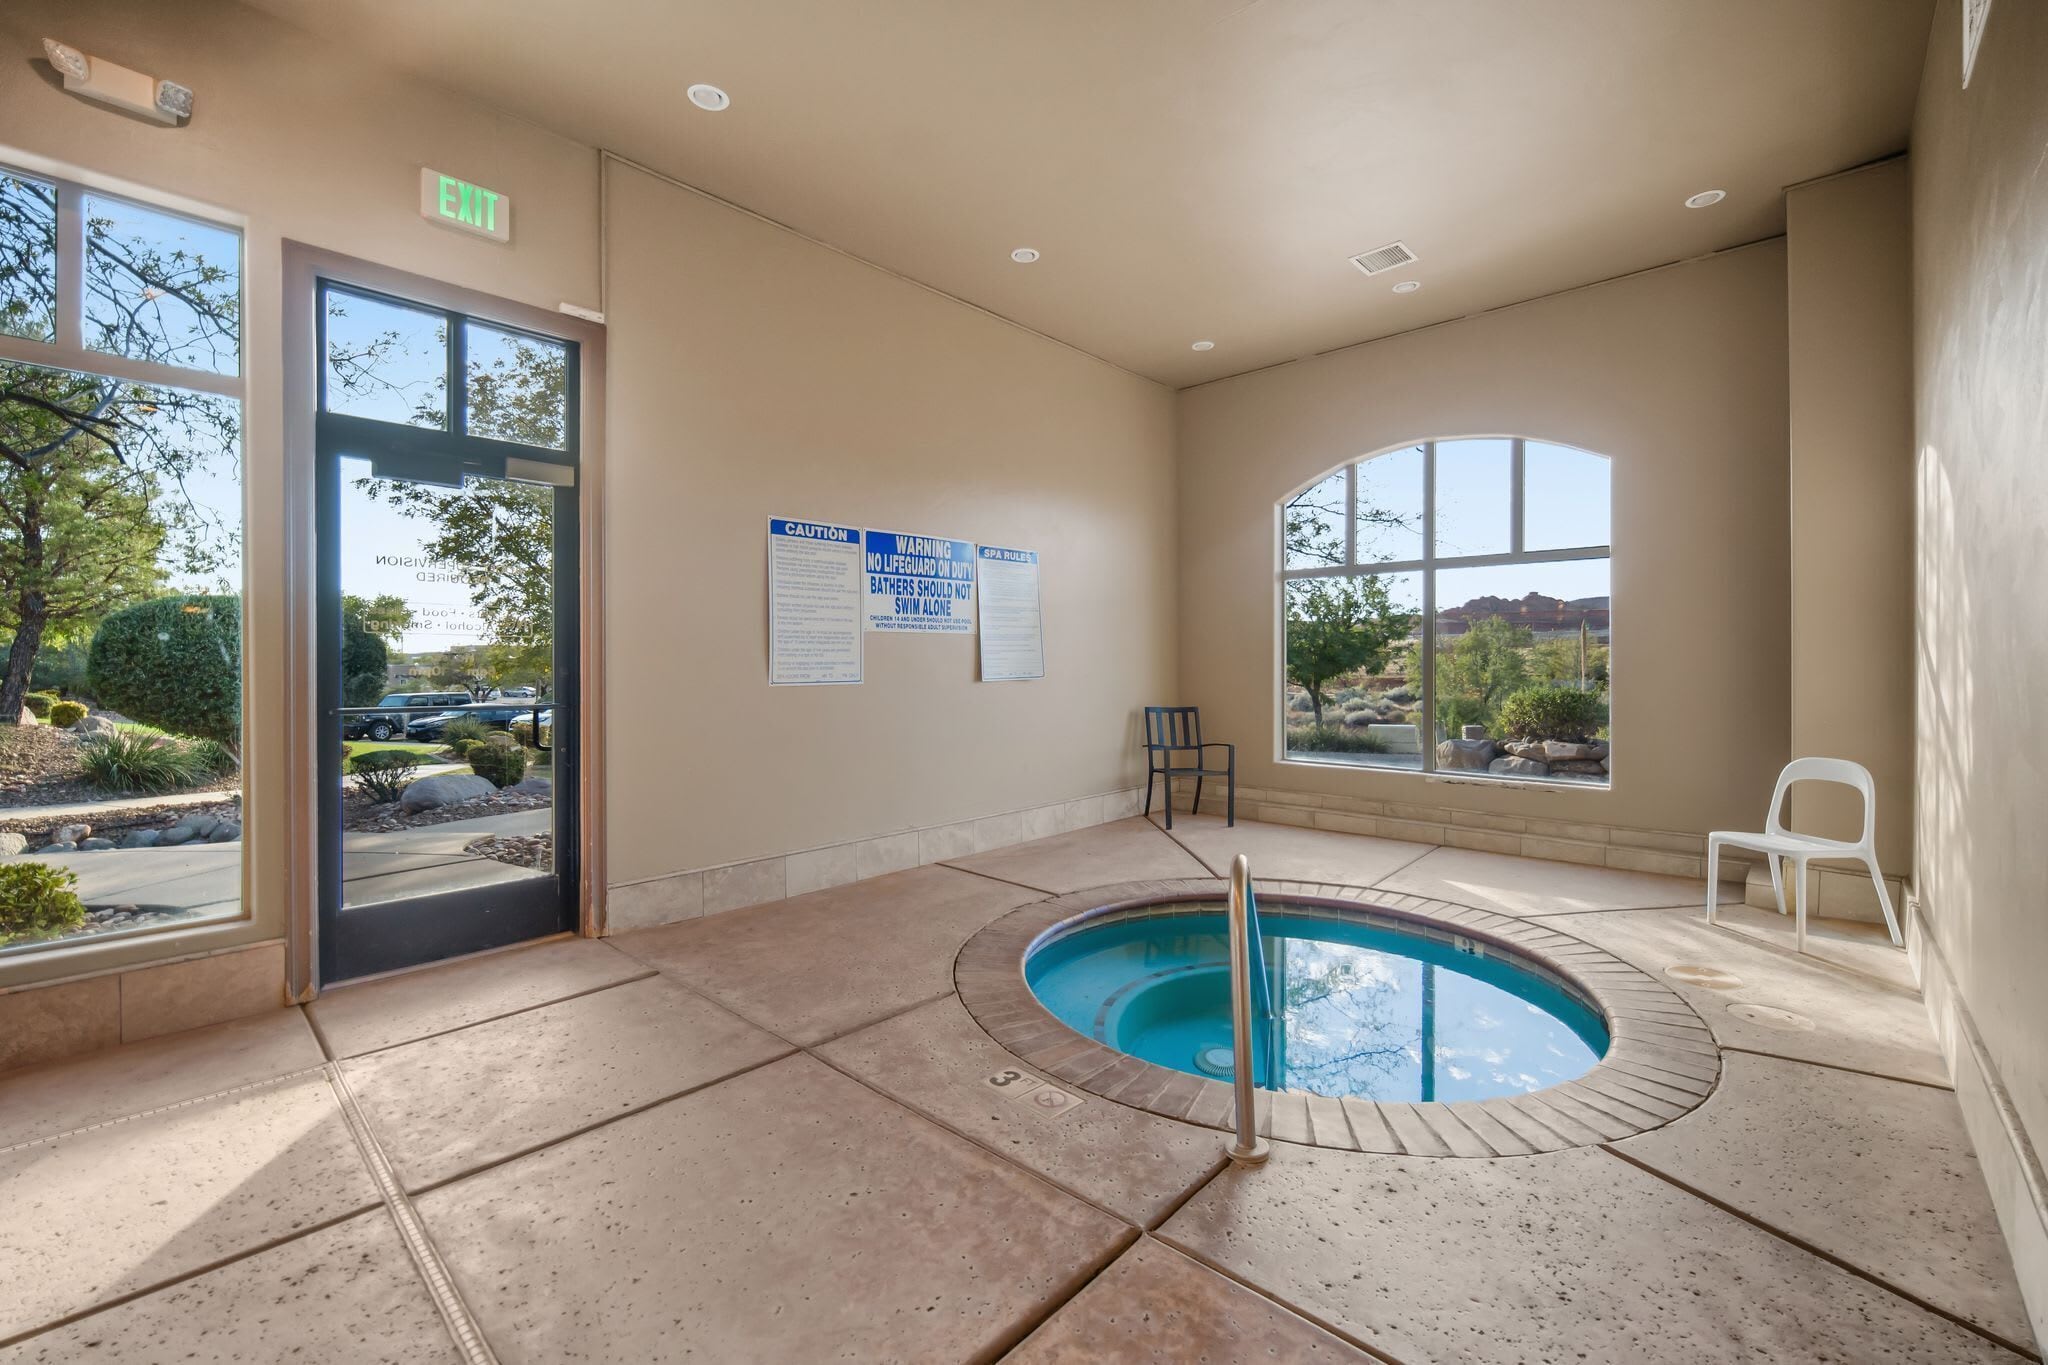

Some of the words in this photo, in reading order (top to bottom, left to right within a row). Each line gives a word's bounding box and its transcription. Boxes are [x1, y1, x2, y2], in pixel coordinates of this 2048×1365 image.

[439, 175, 499, 232] EXIT
[785, 523, 848, 541] CAUTION
[896, 535, 952, 559] WARNING
[984, 549, 1002, 559] SPA
[1004, 551, 1032, 561] RULES
[867, 552, 882, 572] NO
[884, 554, 936, 576] LIFEGUARD
[938, 559, 950, 578] ON
[951, 561, 973, 579] DUTY
[870, 576, 915, 596] BATHERS
[917, 580, 953, 599] SHOULD
[955, 583, 972, 600] NOT
[895, 597, 920, 615] SWIM
[923, 599, 952, 616] ALONE
[989, 1070, 1021, 1087] 3
